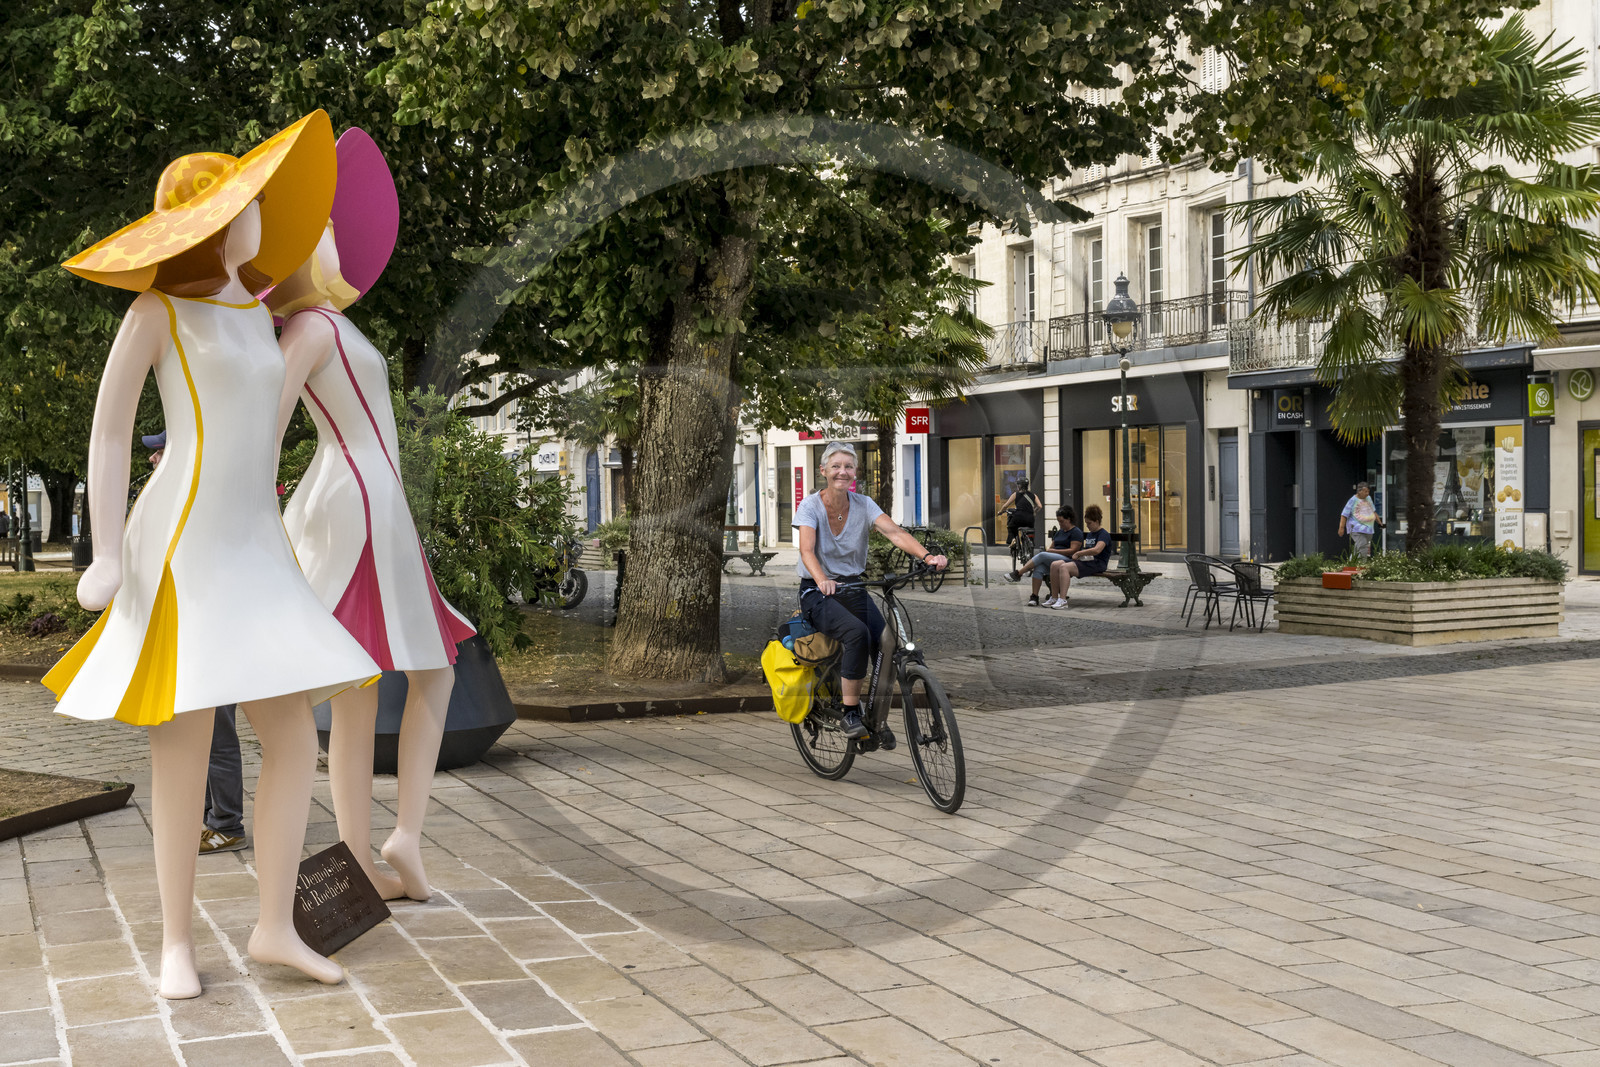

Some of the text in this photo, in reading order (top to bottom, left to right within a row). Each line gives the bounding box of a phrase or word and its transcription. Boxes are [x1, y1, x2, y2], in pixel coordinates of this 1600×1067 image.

[1278, 396, 1302, 412] OR
[911, 415, 928, 426] SFR
[299, 857, 348, 890] Demoiselles
[300, 896, 314, 913] de
